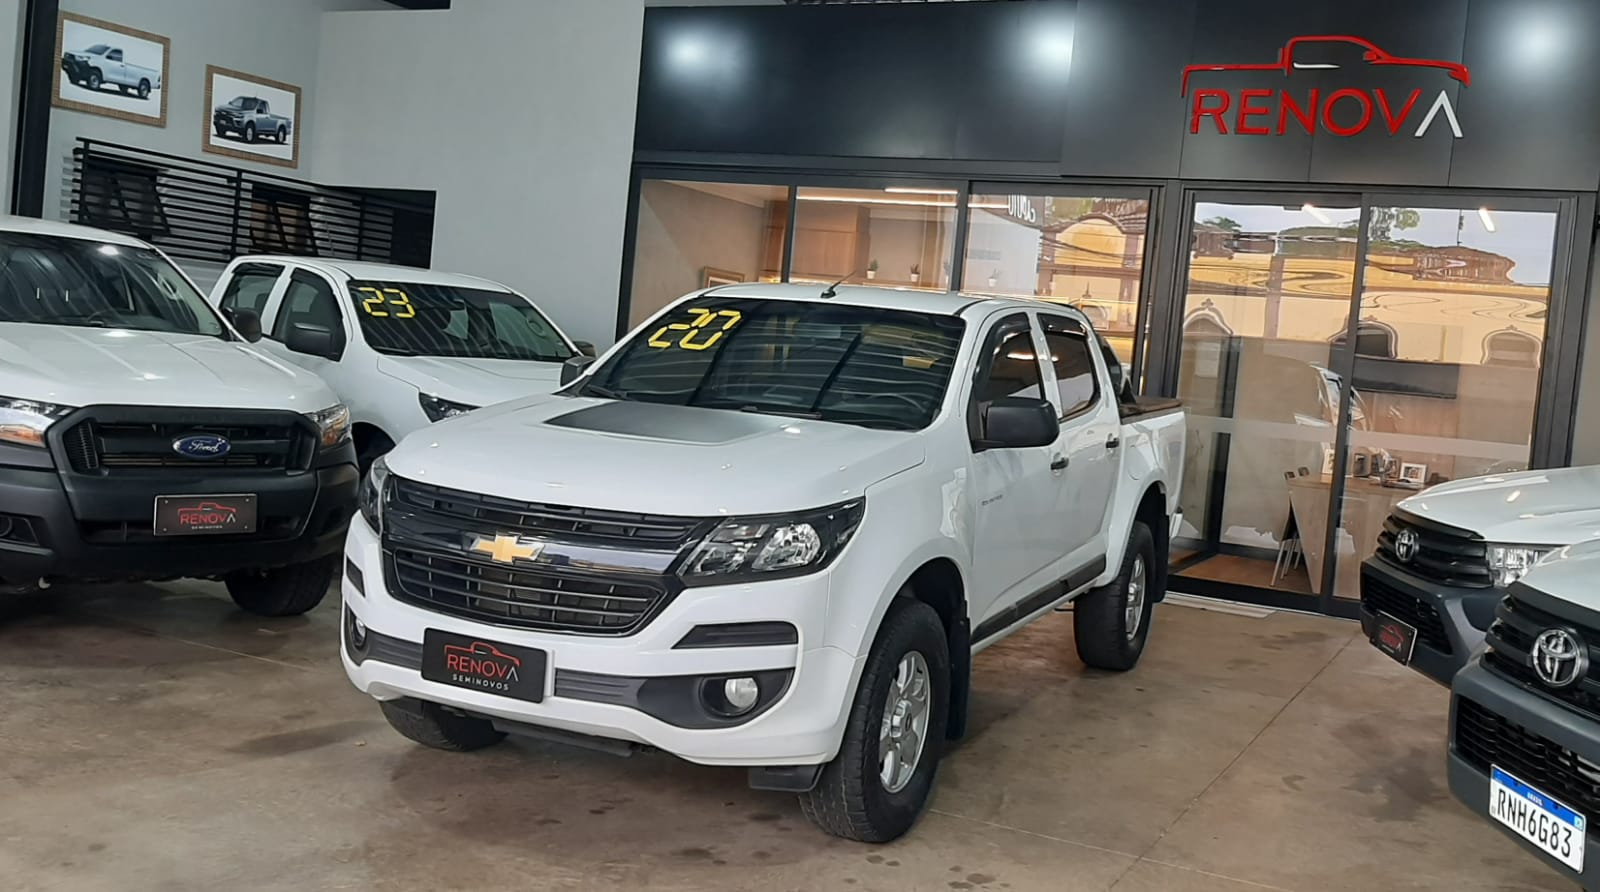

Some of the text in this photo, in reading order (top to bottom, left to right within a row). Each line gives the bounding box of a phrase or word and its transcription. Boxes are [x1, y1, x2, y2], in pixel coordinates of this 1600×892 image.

[1189, 88, 1463, 138] RENOVA
[358, 287, 415, 318] 23
[648, 308, 741, 350] 20
[188, 439, 222, 453] Ford
[180, 513, 236, 525] RENOVA
[447, 654, 519, 682] RENOVA
[452, 673, 509, 690] SEMINOVOS
[1497, 788, 1572, 858] RNH6G83
